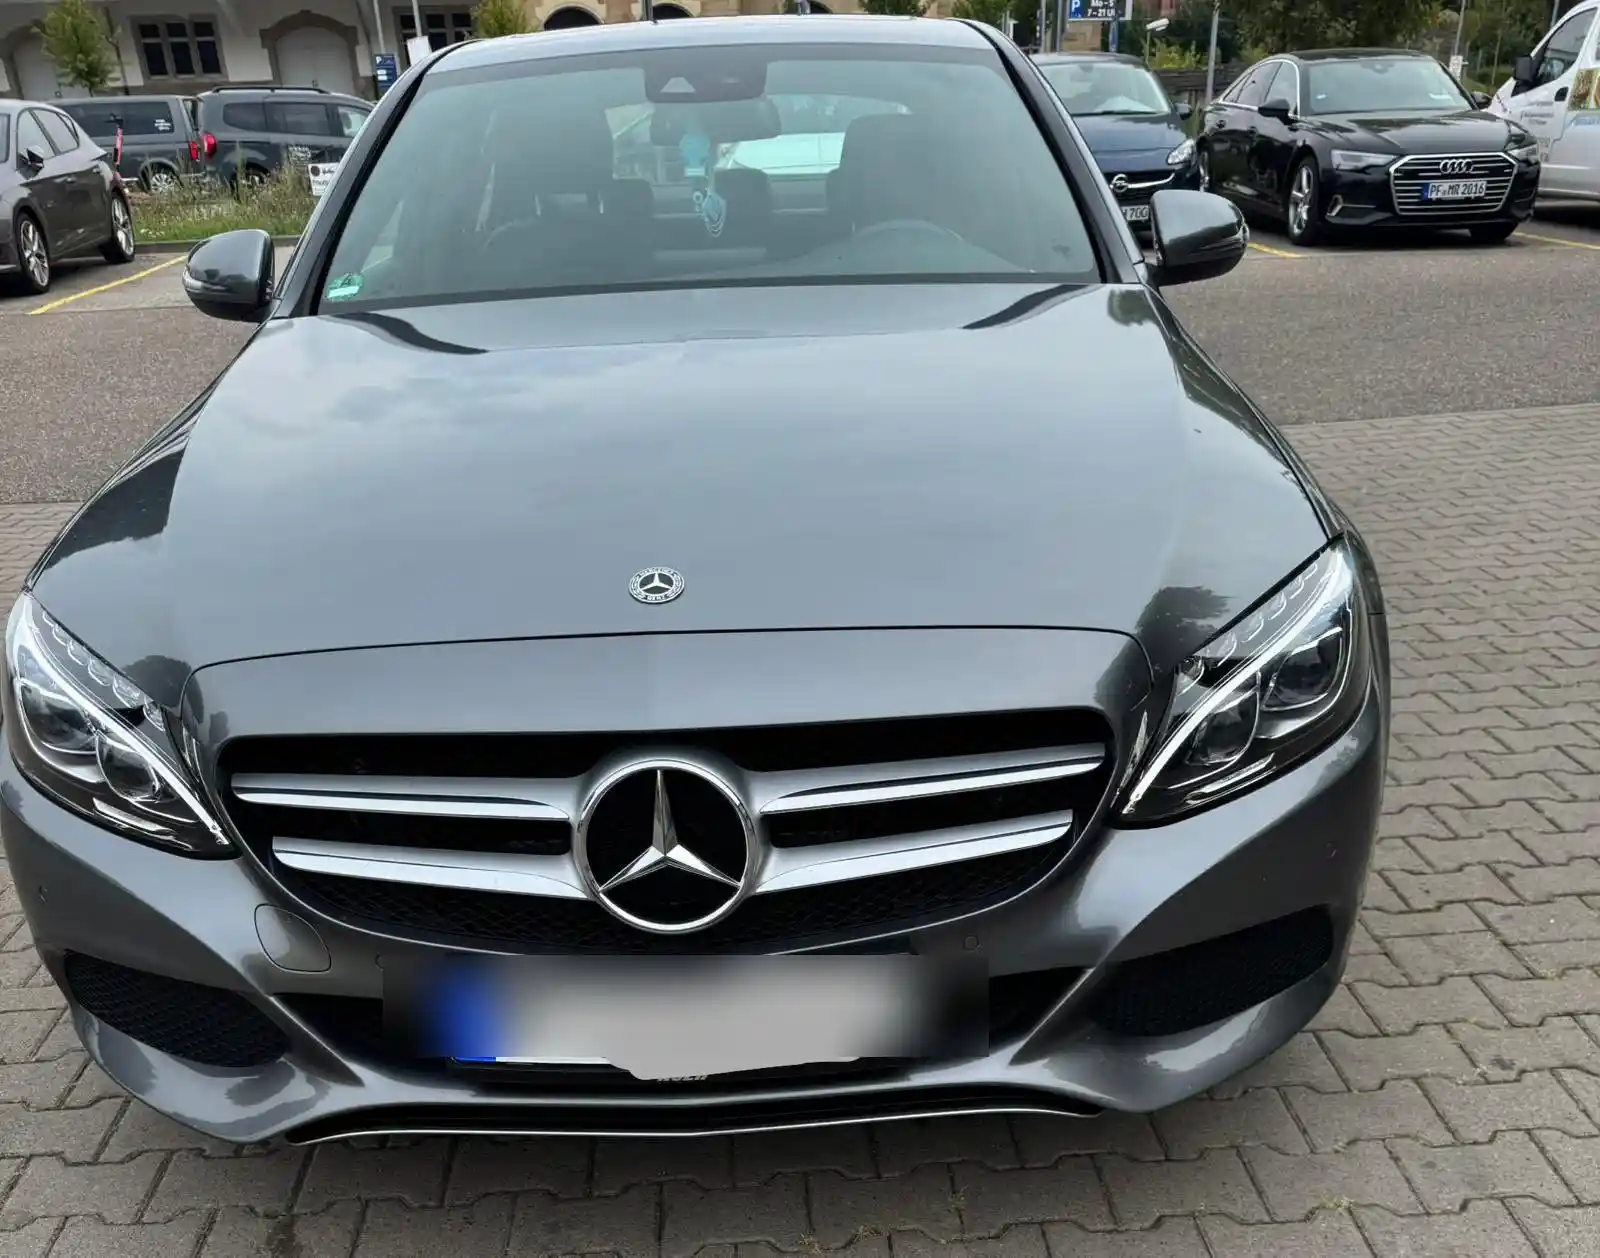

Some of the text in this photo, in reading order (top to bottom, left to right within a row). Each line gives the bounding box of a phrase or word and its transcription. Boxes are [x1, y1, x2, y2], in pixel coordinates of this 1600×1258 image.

[1429, 182, 1486, 197] PF MR 2016
